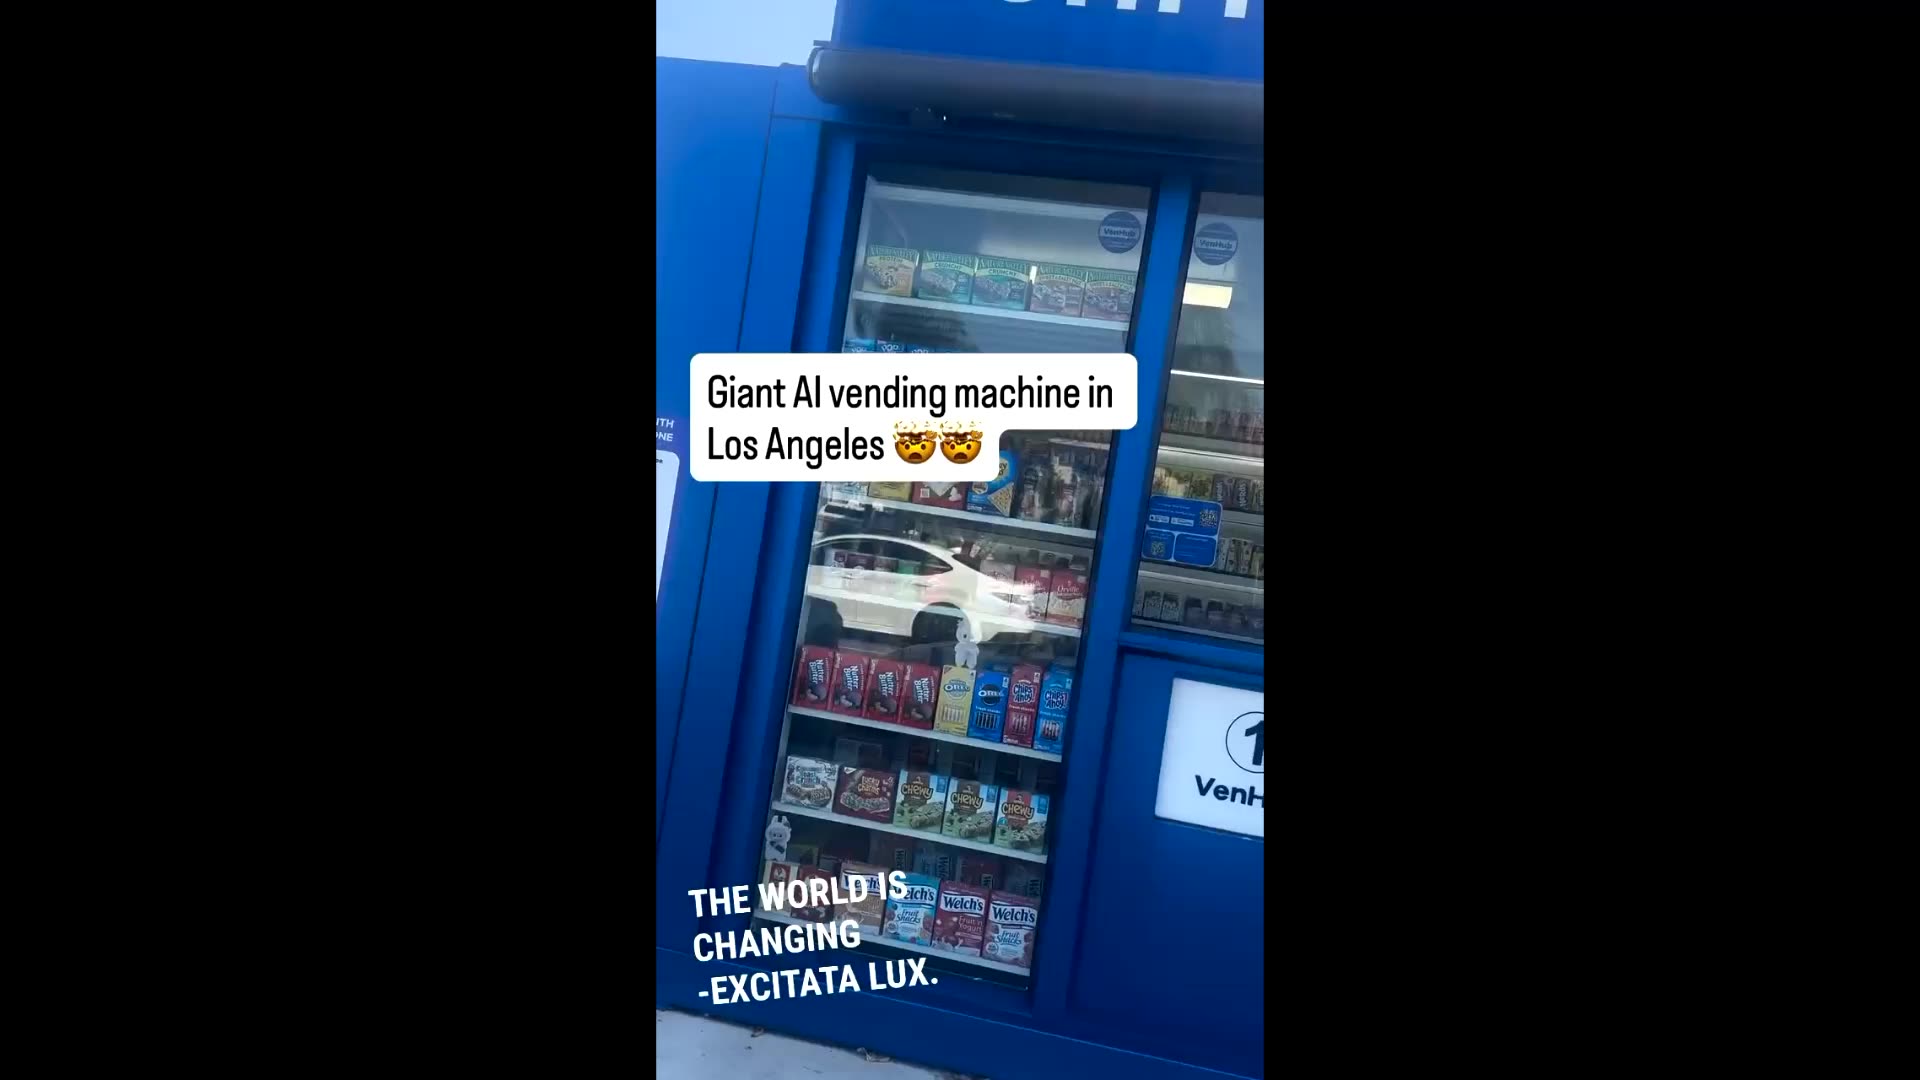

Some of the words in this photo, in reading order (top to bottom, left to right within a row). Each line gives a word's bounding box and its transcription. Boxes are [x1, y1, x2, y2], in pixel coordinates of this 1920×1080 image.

[1103, 227, 1136, 238] VenHub
[809, 661, 818, 685] Butter
[816, 659, 825, 683] Nutter
[843, 667, 853, 691] Butter
[850, 665, 859, 689] Nutter
[878, 673, 888, 697] Butter
[885, 671, 894, 696] Nutter
[920, 677, 929, 702] Nutter
[913, 680, 923, 704] Butter
[1245, 720, 1264, 766] 1
[861, 775, 881, 786] Lucky
[857, 783, 881, 795] Charms
[943, 896, 983, 911] Welch's
[896, 913, 921, 924] Snacks
[902, 909, 919, 918] Fruit
[959, 916, 977, 925] Fruit
[992, 905, 1035, 923] Welch's
[959, 924, 983, 934] Yogurt
[1001, 930, 1020, 939] Fruit
[996, 936, 1022, 945] Snacks
